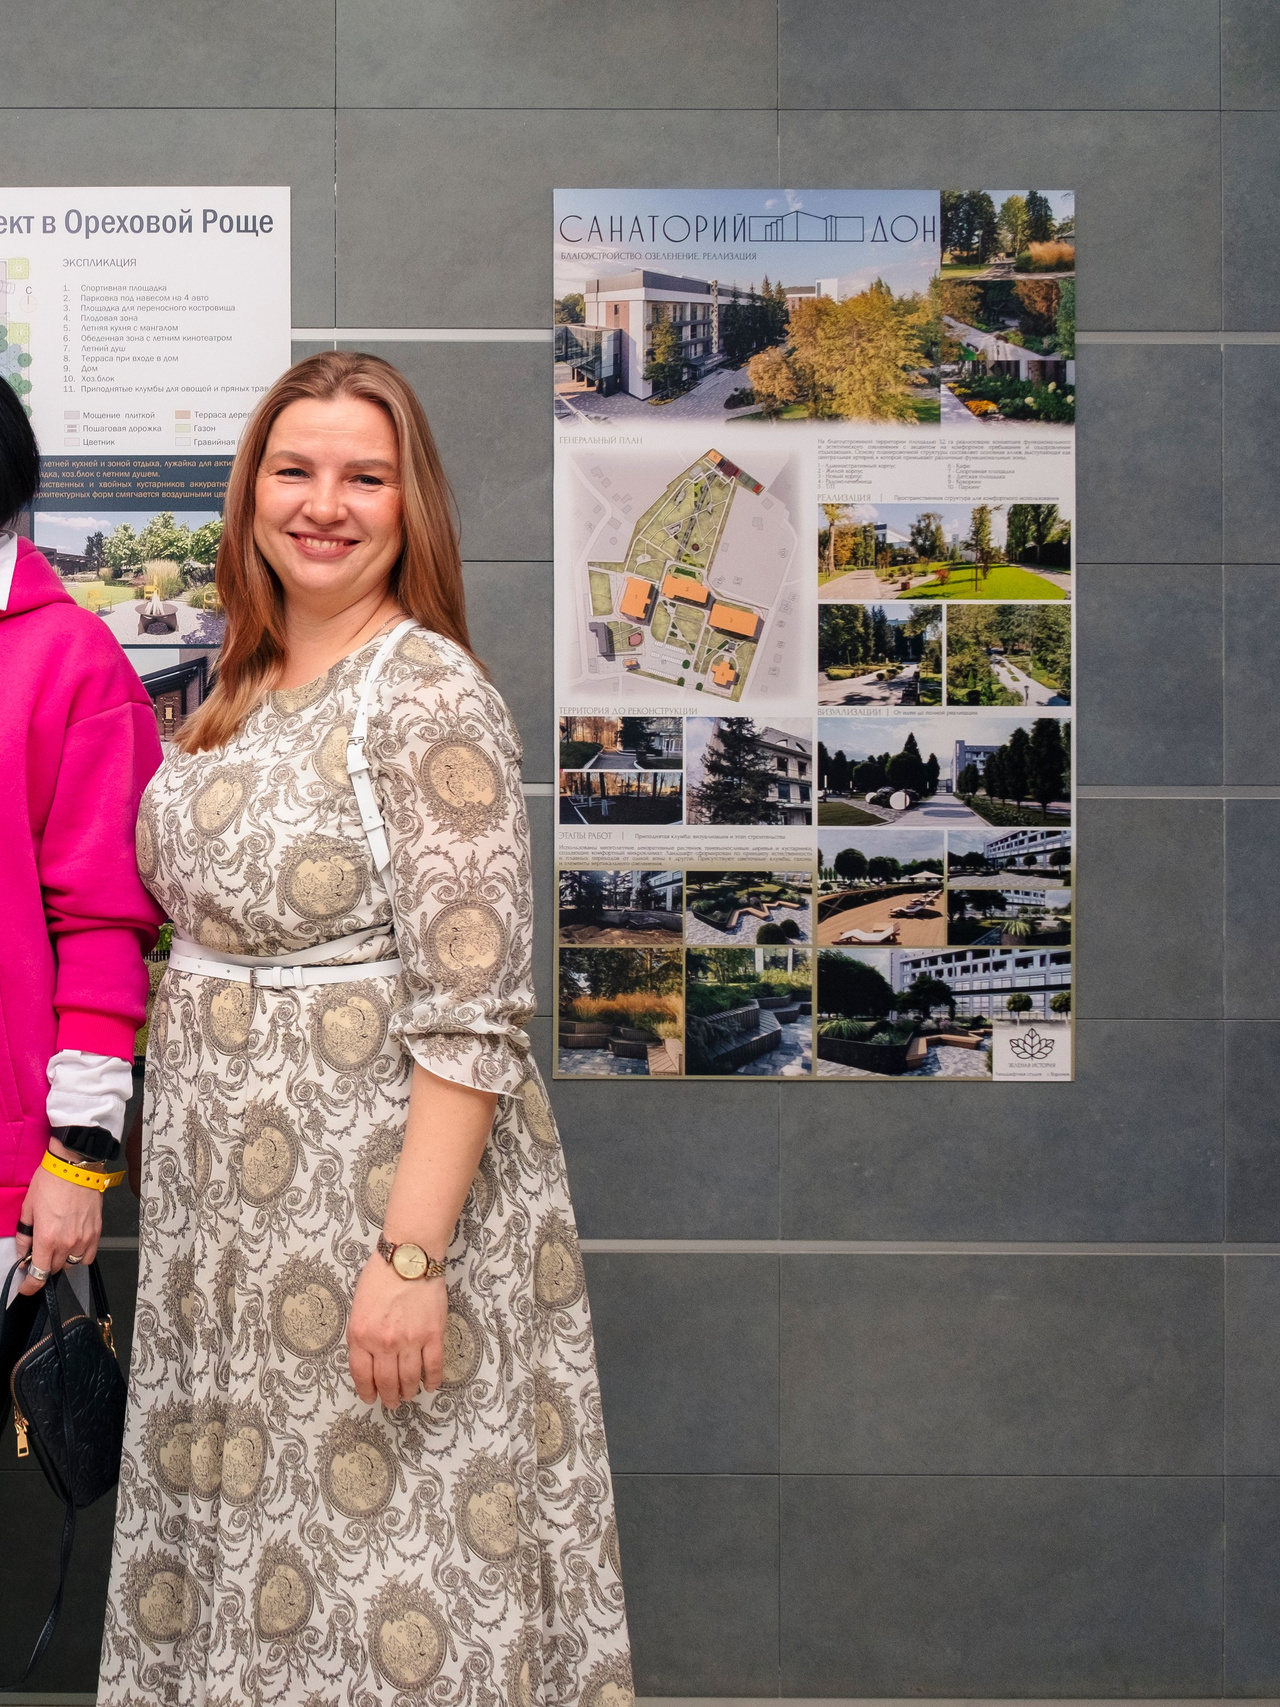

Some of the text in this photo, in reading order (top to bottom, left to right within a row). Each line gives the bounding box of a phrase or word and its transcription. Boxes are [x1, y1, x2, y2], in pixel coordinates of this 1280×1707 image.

[42, 216, 56, 234] в
[65, 208, 192, 239] Ореховой
[202, 209, 274, 237] Роще
[559, 213, 935, 243] САНАТОРИЙ ДОН
[702, 252, 757, 260] РЕАЛИЗАЦИЯ
[62, 258, 137, 268] ЭКСПЛИКАЦИЯ
[63, 284, 70, 292] 1.
[80, 284, 127, 293] Спортивная
[63, 294, 70, 302] 2.
[80, 294, 118, 303] Парковка
[63, 304, 71, 312] 3.
[80, 304, 120, 312] Площадка
[63, 314, 71, 322] 4.
[80, 314, 118, 322] Плодовая
[63, 324, 71, 332] 5.
[81, 324, 108, 332] Летняя
[110, 325, 132, 333] кухня
[63, 334, 71, 342] 6.
[81, 334, 124, 342] Обеденная
[182, 335, 232, 343] кинотеатром
[63, 344, 70, 352] 7.
[81, 344, 109, 352] Летний
[63, 354, 71, 362] 8.
[81, 354, 114, 363] Терраса
[63, 364, 98, 373] 9. Дом
[63, 375, 115, 383] 10. Хоз.блок
[64, 385, 76, 393] 11.
[81, 385, 133, 394] Приподнятые
[135, 385, 164, 394] клумбы
[180, 385, 212, 393] овощей
[125, 411, 155, 419] плиткой
[194, 411, 227, 420] Терраса
[193, 424, 216, 432] Газон
[83, 438, 115, 447] Цветник
[194, 438, 236, 447] Гравийная
[559, 436, 643, 444] ГЕНЕРАЛЬНЫЙ ПЛАН
[43, 460, 69, 468] летней
[72, 459, 98, 469] кухней
[107, 459, 131, 467] зоной
[164, 459, 197, 469] лужайка
[61, 470, 95, 478] хоз.блок
[131, 471, 160, 479] душем.
[99, 480, 132, 488] хвойных
[136, 481, 185, 489] кустарников
[92, 491, 114, 499] форм
[161, 491, 212, 499] воздушными
[817, 493, 871, 503] РЕАЛИЗАЦИЯ
[559, 707, 698, 715] ТЕРРИТОРИЯ ДО РЕКОНСТРУКЦИИ
[817, 708, 881, 718] ВИЗУАЛИЗАЦИИ
[558, 831, 586, 840] ЭТАПЫ
[588, 831, 613, 840] РАБОТ
